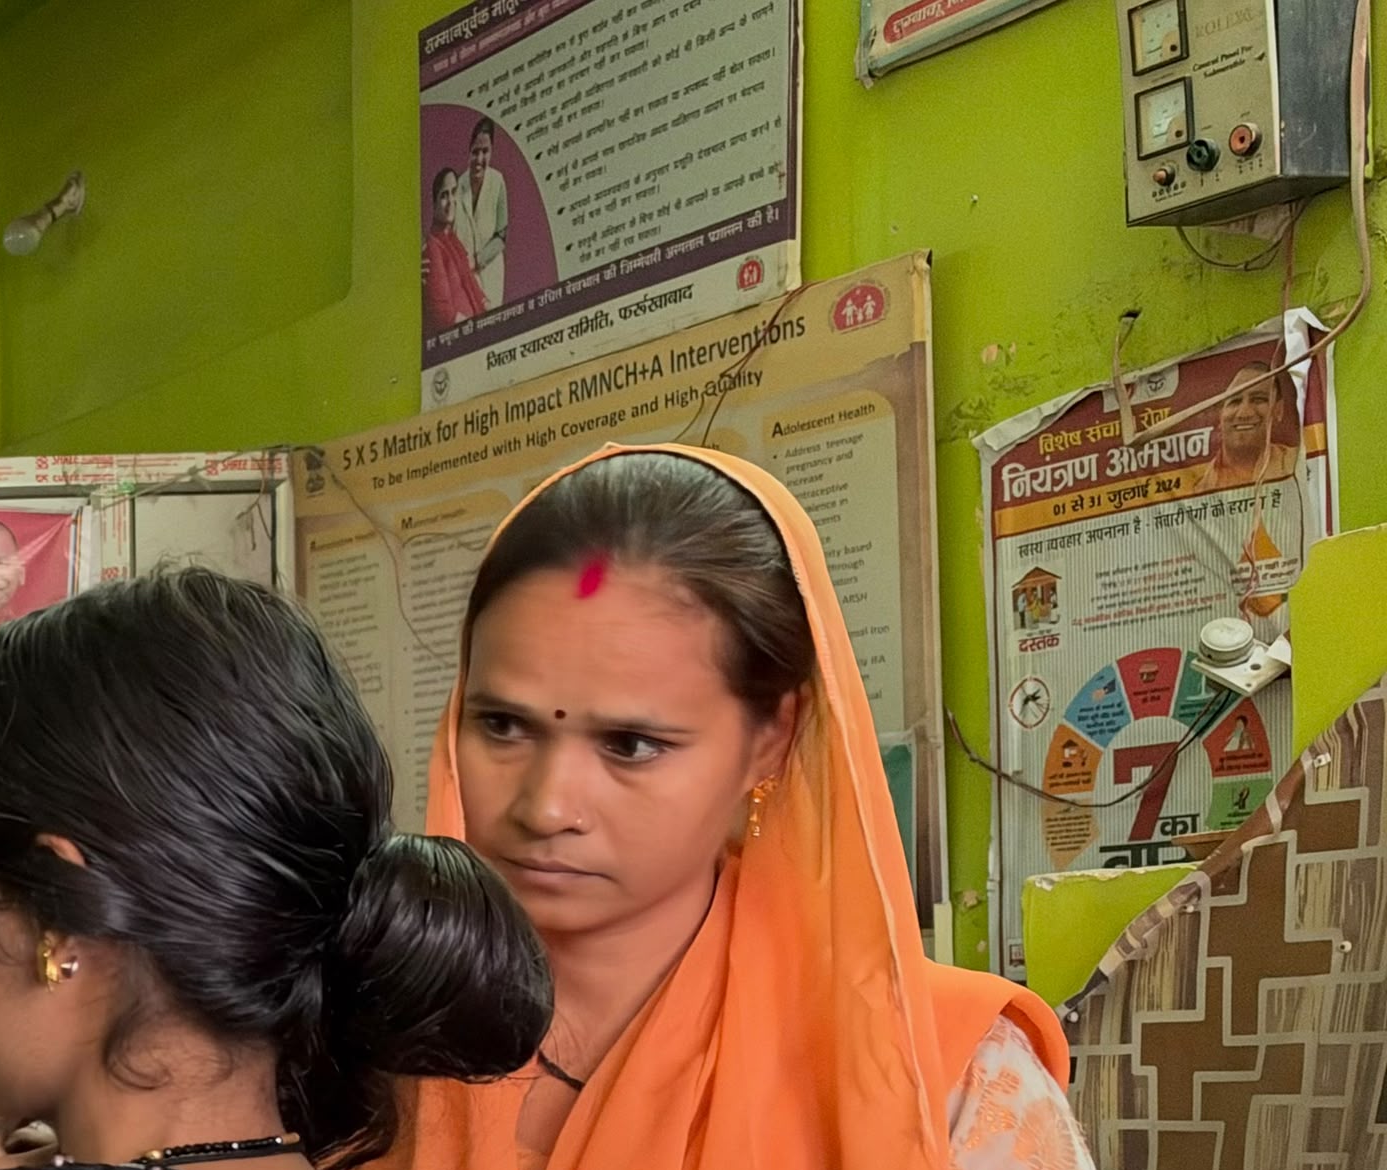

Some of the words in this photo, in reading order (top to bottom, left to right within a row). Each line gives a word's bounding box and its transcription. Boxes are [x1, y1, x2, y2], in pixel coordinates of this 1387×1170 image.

[747, 210, 761, 230] की
[487, 342, 516, 372] जिला
[520, 328, 563, 359] स्वास्थ्य
[568, 304, 613, 345] समिति,
[343, 450, 351, 471] 5
[356, 446, 366, 467] X
[370, 440, 378, 462] 5
[383, 427, 432, 460] Matrix
[437, 416, 457, 443] for
[463, 406, 499, 436] High
[505, 388, 565, 427] Impact
[568, 357, 665, 404] RMNCH+A
[670, 315, 806, 374] Interventions
[373, 475, 386, 490] To
[389, 471, 402, 486] be
[406, 446, 488, 482] Implemented
[492, 440, 522, 460] with
[526, 428, 556, 452] High
[561, 406, 626, 439] Coverage
[631, 397, 658, 418] and
[664, 384, 698, 409] High
[702, 368, 764, 398] Quality
[772, 414, 835, 438] Adolescent
[838, 403, 876, 421] Health
[785, 443, 821, 458] Address
[826, 433, 864, 450] teenage
[1039, 431, 1082, 455] विशेष
[786, 455, 833, 475] pregnancy
[836, 450, 854, 462] and
[1001, 455, 1099, 502] नियंत्रण
[796, 482, 849, 499] ntraceptive
[1053, 502, 1066, 516] 01
[1071, 495, 1084, 513] से
[1089, 495, 1102, 508] 31
[1107, 479, 1151, 509] जुलाई
[1086, 522, 1129, 543] अपनाना
[1130, 515, 1141, 535] है
[1211, 499, 1225, 517] को
[1018, 633, 1061, 653] दस्तक
[1113, 741, 1179, 842] 7
[1157, 814, 1200, 834] का
